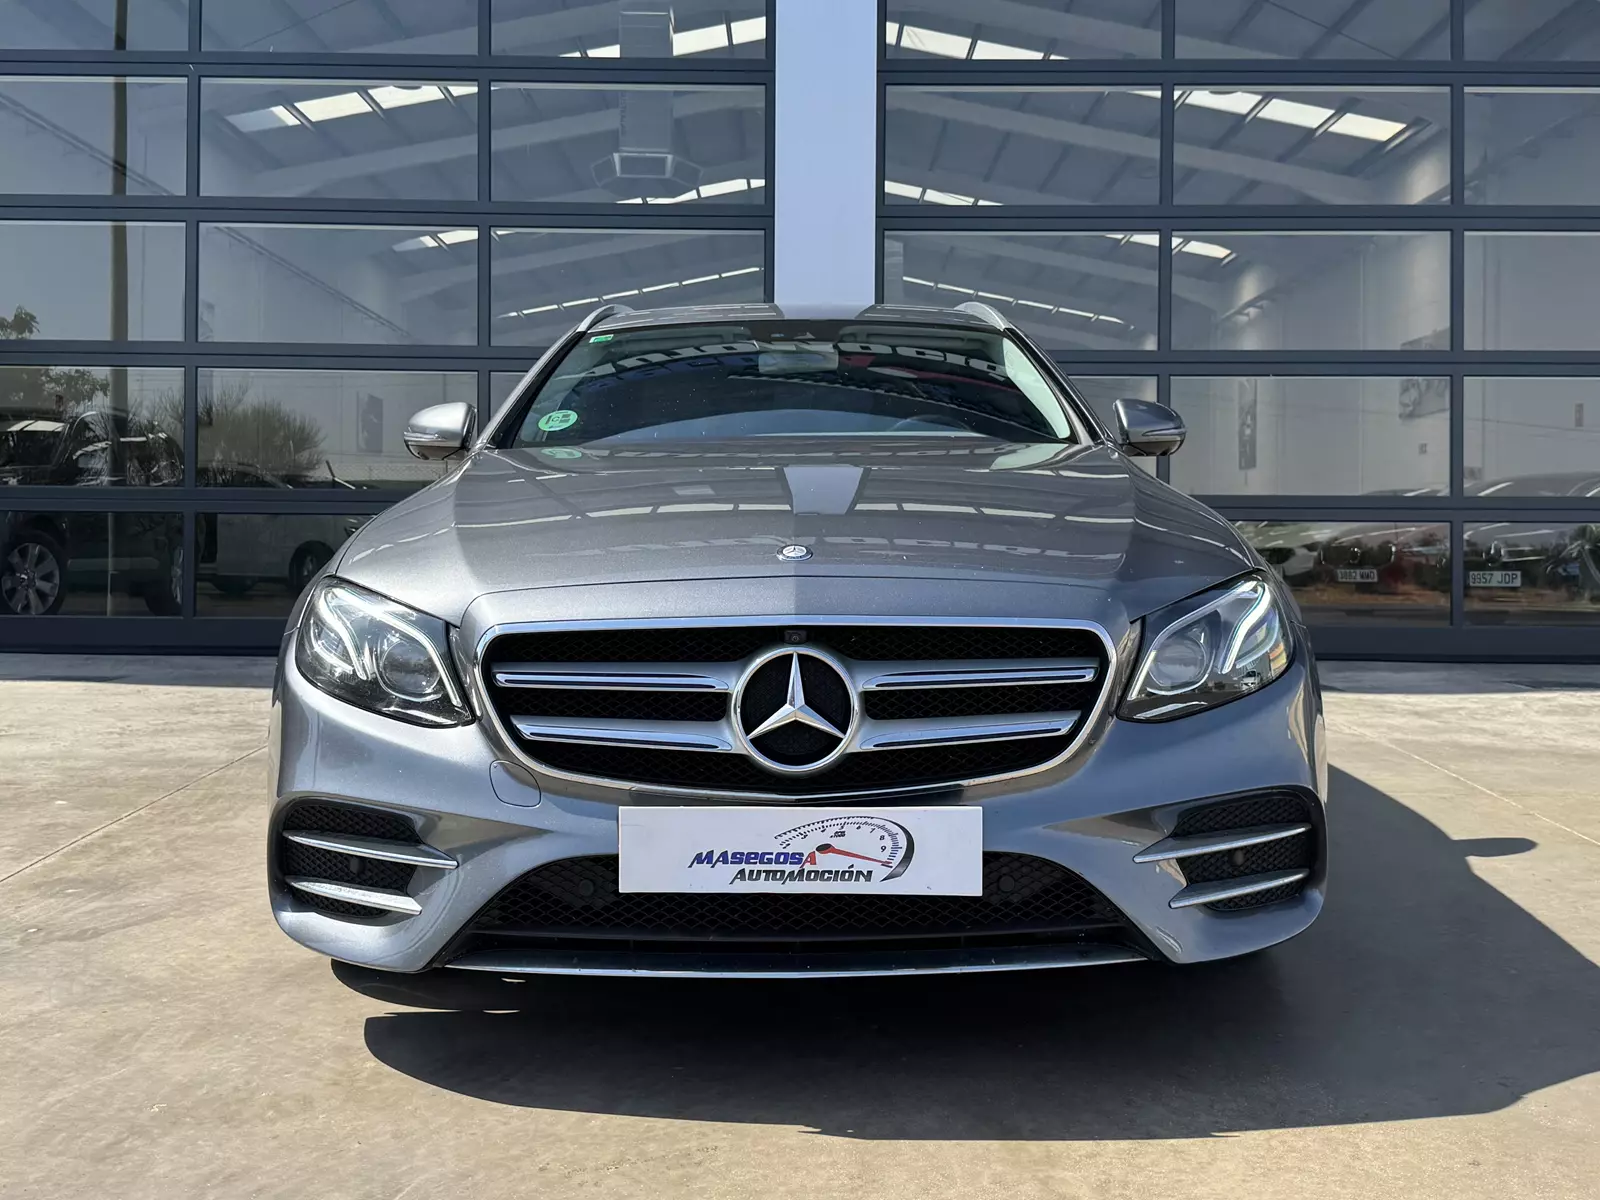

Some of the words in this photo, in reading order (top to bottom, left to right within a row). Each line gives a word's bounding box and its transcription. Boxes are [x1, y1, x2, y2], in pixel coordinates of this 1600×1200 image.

[1497, 572, 1518, 585] JDP
[688, 850, 817, 868] MASEGOSA
[729, 864, 873, 885] AUTOMOCIÓN
